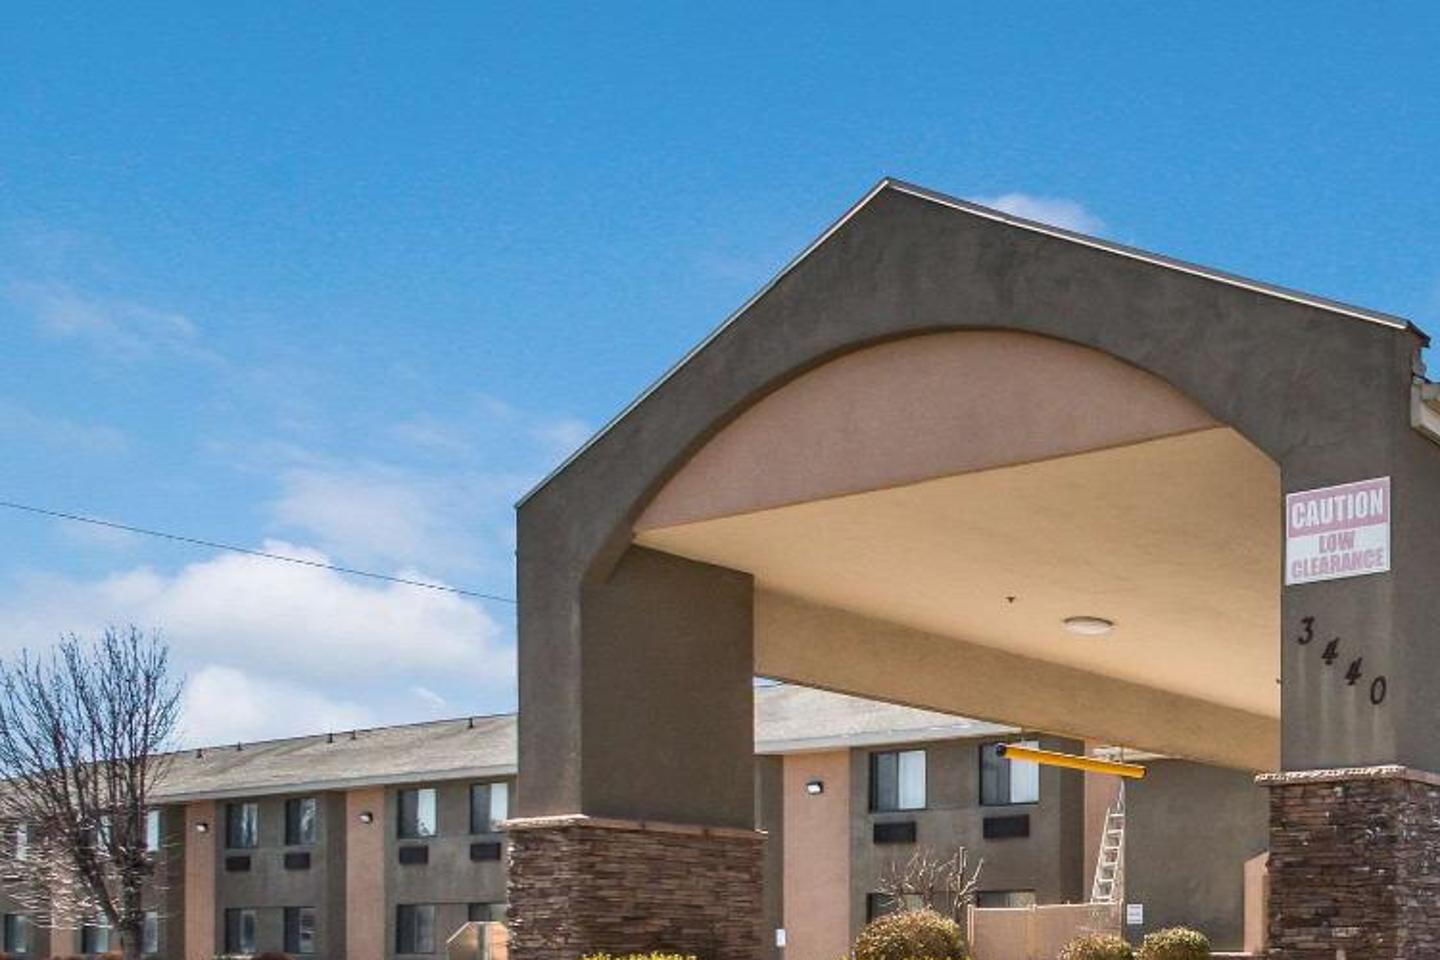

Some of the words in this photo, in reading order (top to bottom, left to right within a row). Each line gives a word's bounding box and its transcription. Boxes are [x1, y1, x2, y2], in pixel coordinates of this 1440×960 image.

[1291, 488, 1384, 529] CAUTION
[1319, 531, 1355, 554] LOW
[1291, 548, 1385, 578] CLEARANCE
[1298, 616, 1387, 705] 3440
